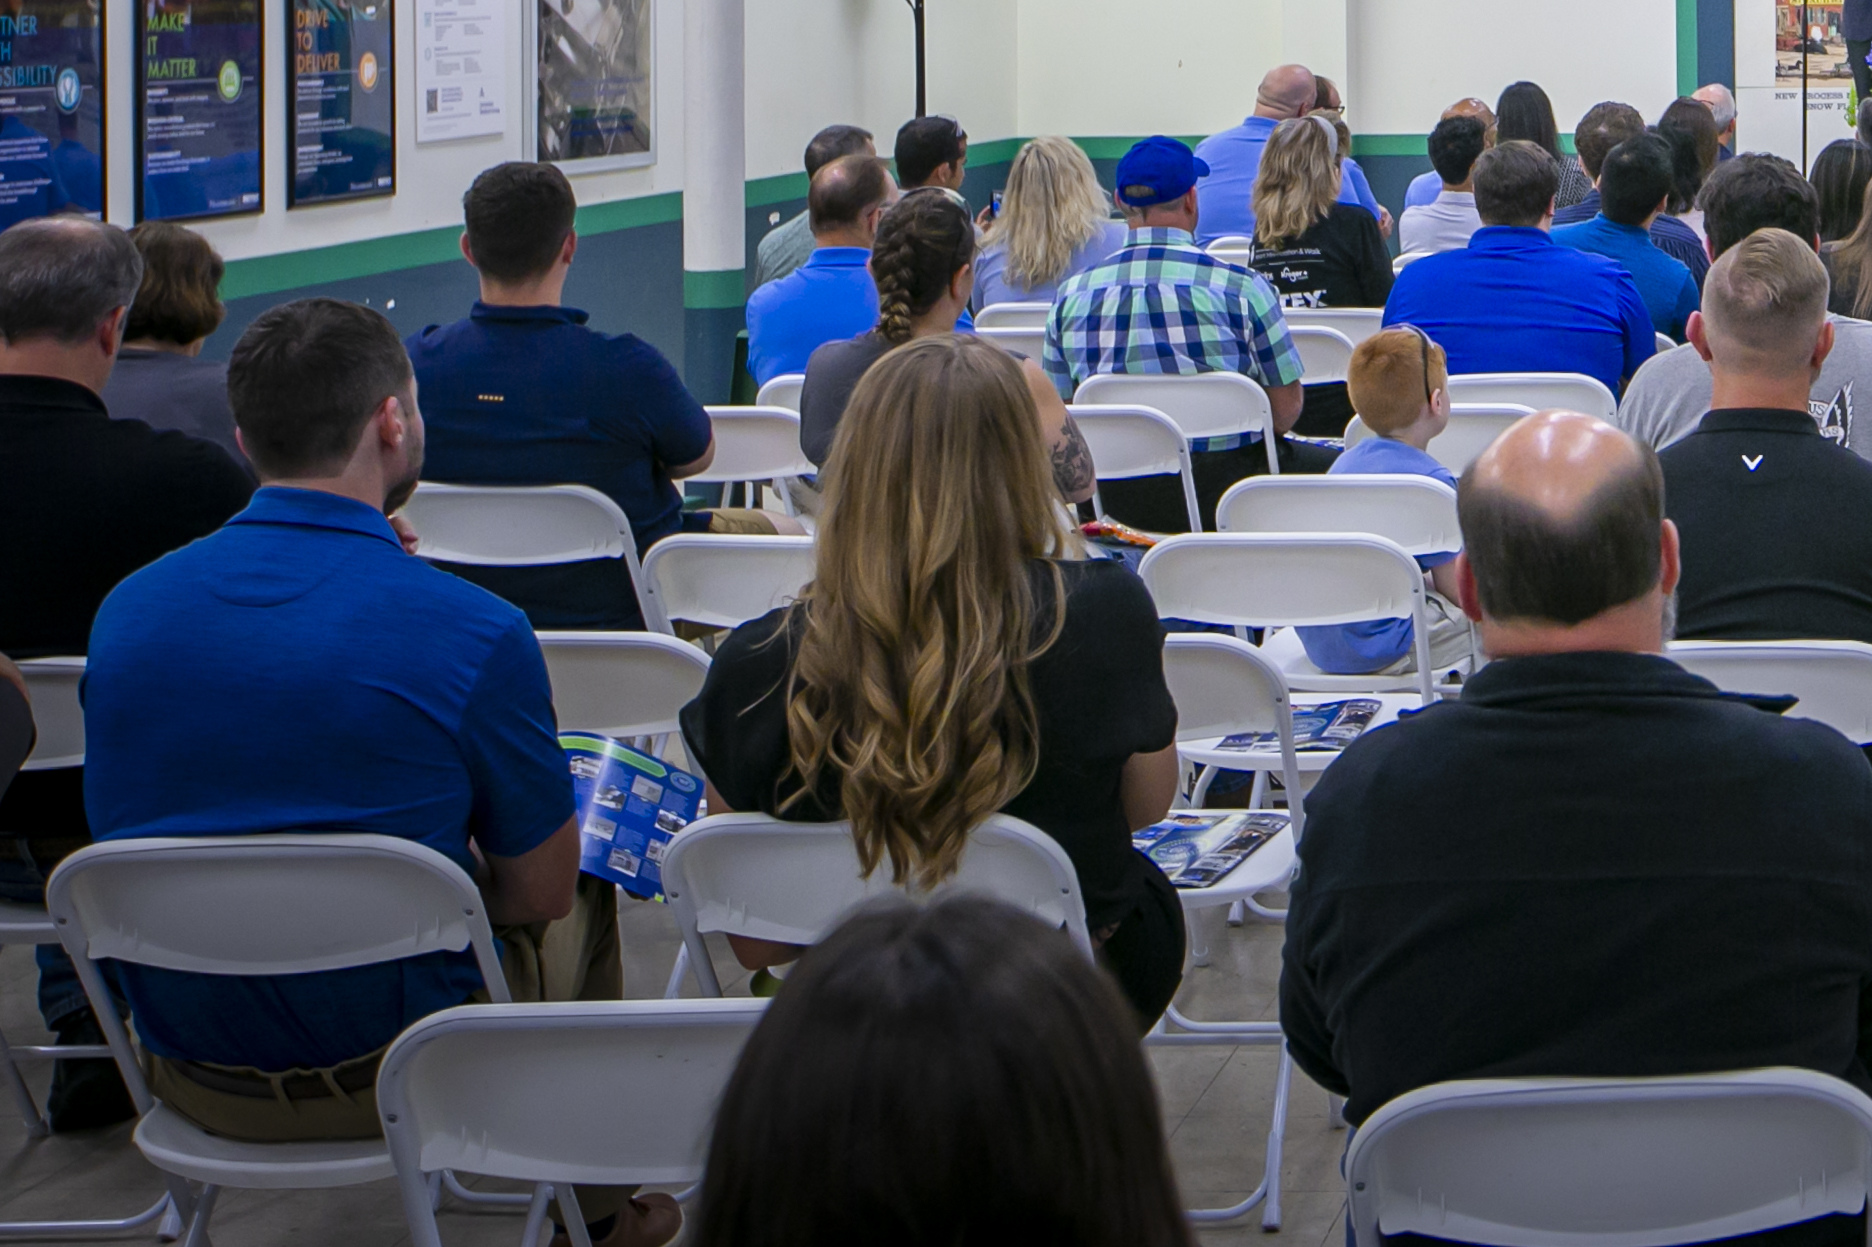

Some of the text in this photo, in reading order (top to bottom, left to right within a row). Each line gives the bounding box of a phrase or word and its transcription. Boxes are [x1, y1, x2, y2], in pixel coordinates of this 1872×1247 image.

[147, 11, 185, 32] MAKE
[296, 9, 329, 29] DRIVE
[147, 35, 158, 56] IT
[296, 31, 313, 51] TO
[147, 57, 197, 79] MATTER
[296, 52, 341, 73] DELIVER
[1775, 92, 1798, 100] NEW
[1807, 92, 1844, 100] ROCESS
[1280, 266, 1303, 283] Kroger
